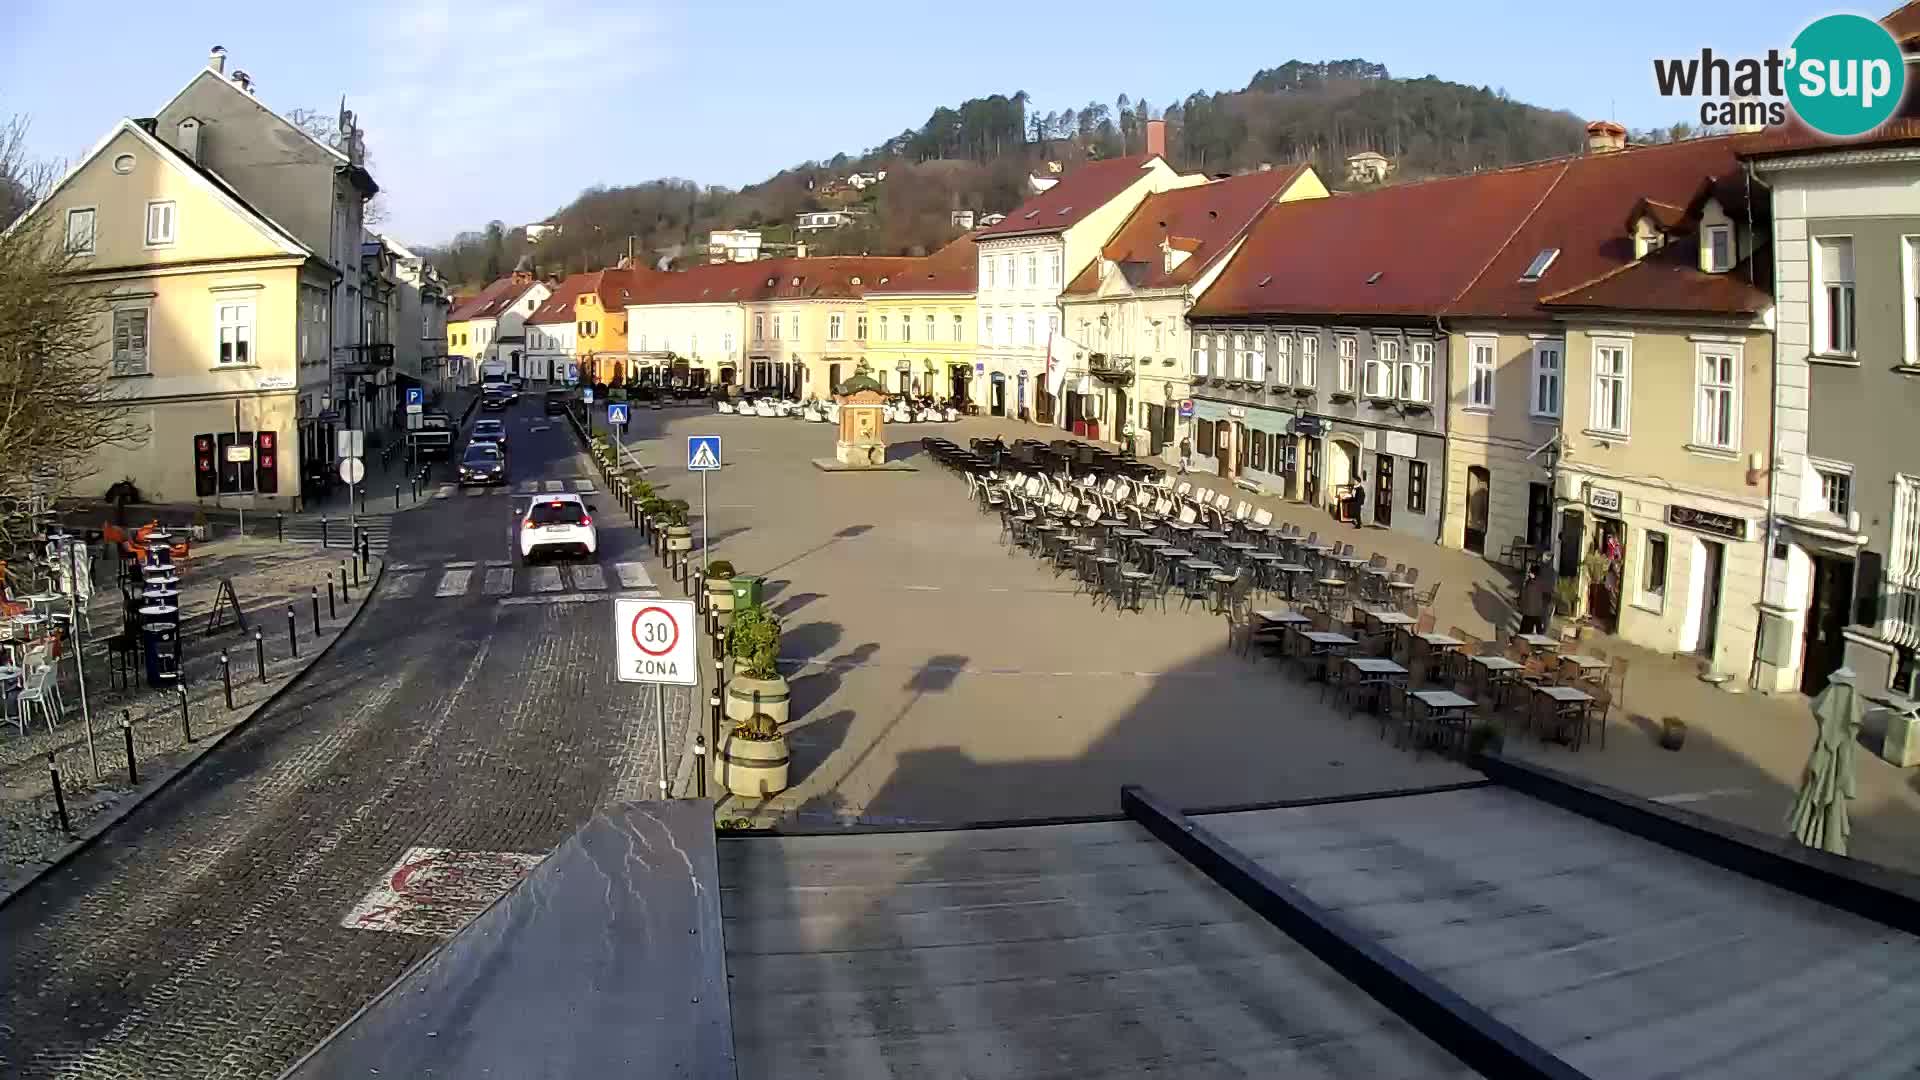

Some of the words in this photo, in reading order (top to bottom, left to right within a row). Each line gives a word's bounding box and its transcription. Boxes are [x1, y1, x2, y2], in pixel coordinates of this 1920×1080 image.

[410, 391, 418, 402] P
[644, 622, 668, 643] 30
[634, 660, 679, 676] ZONA
